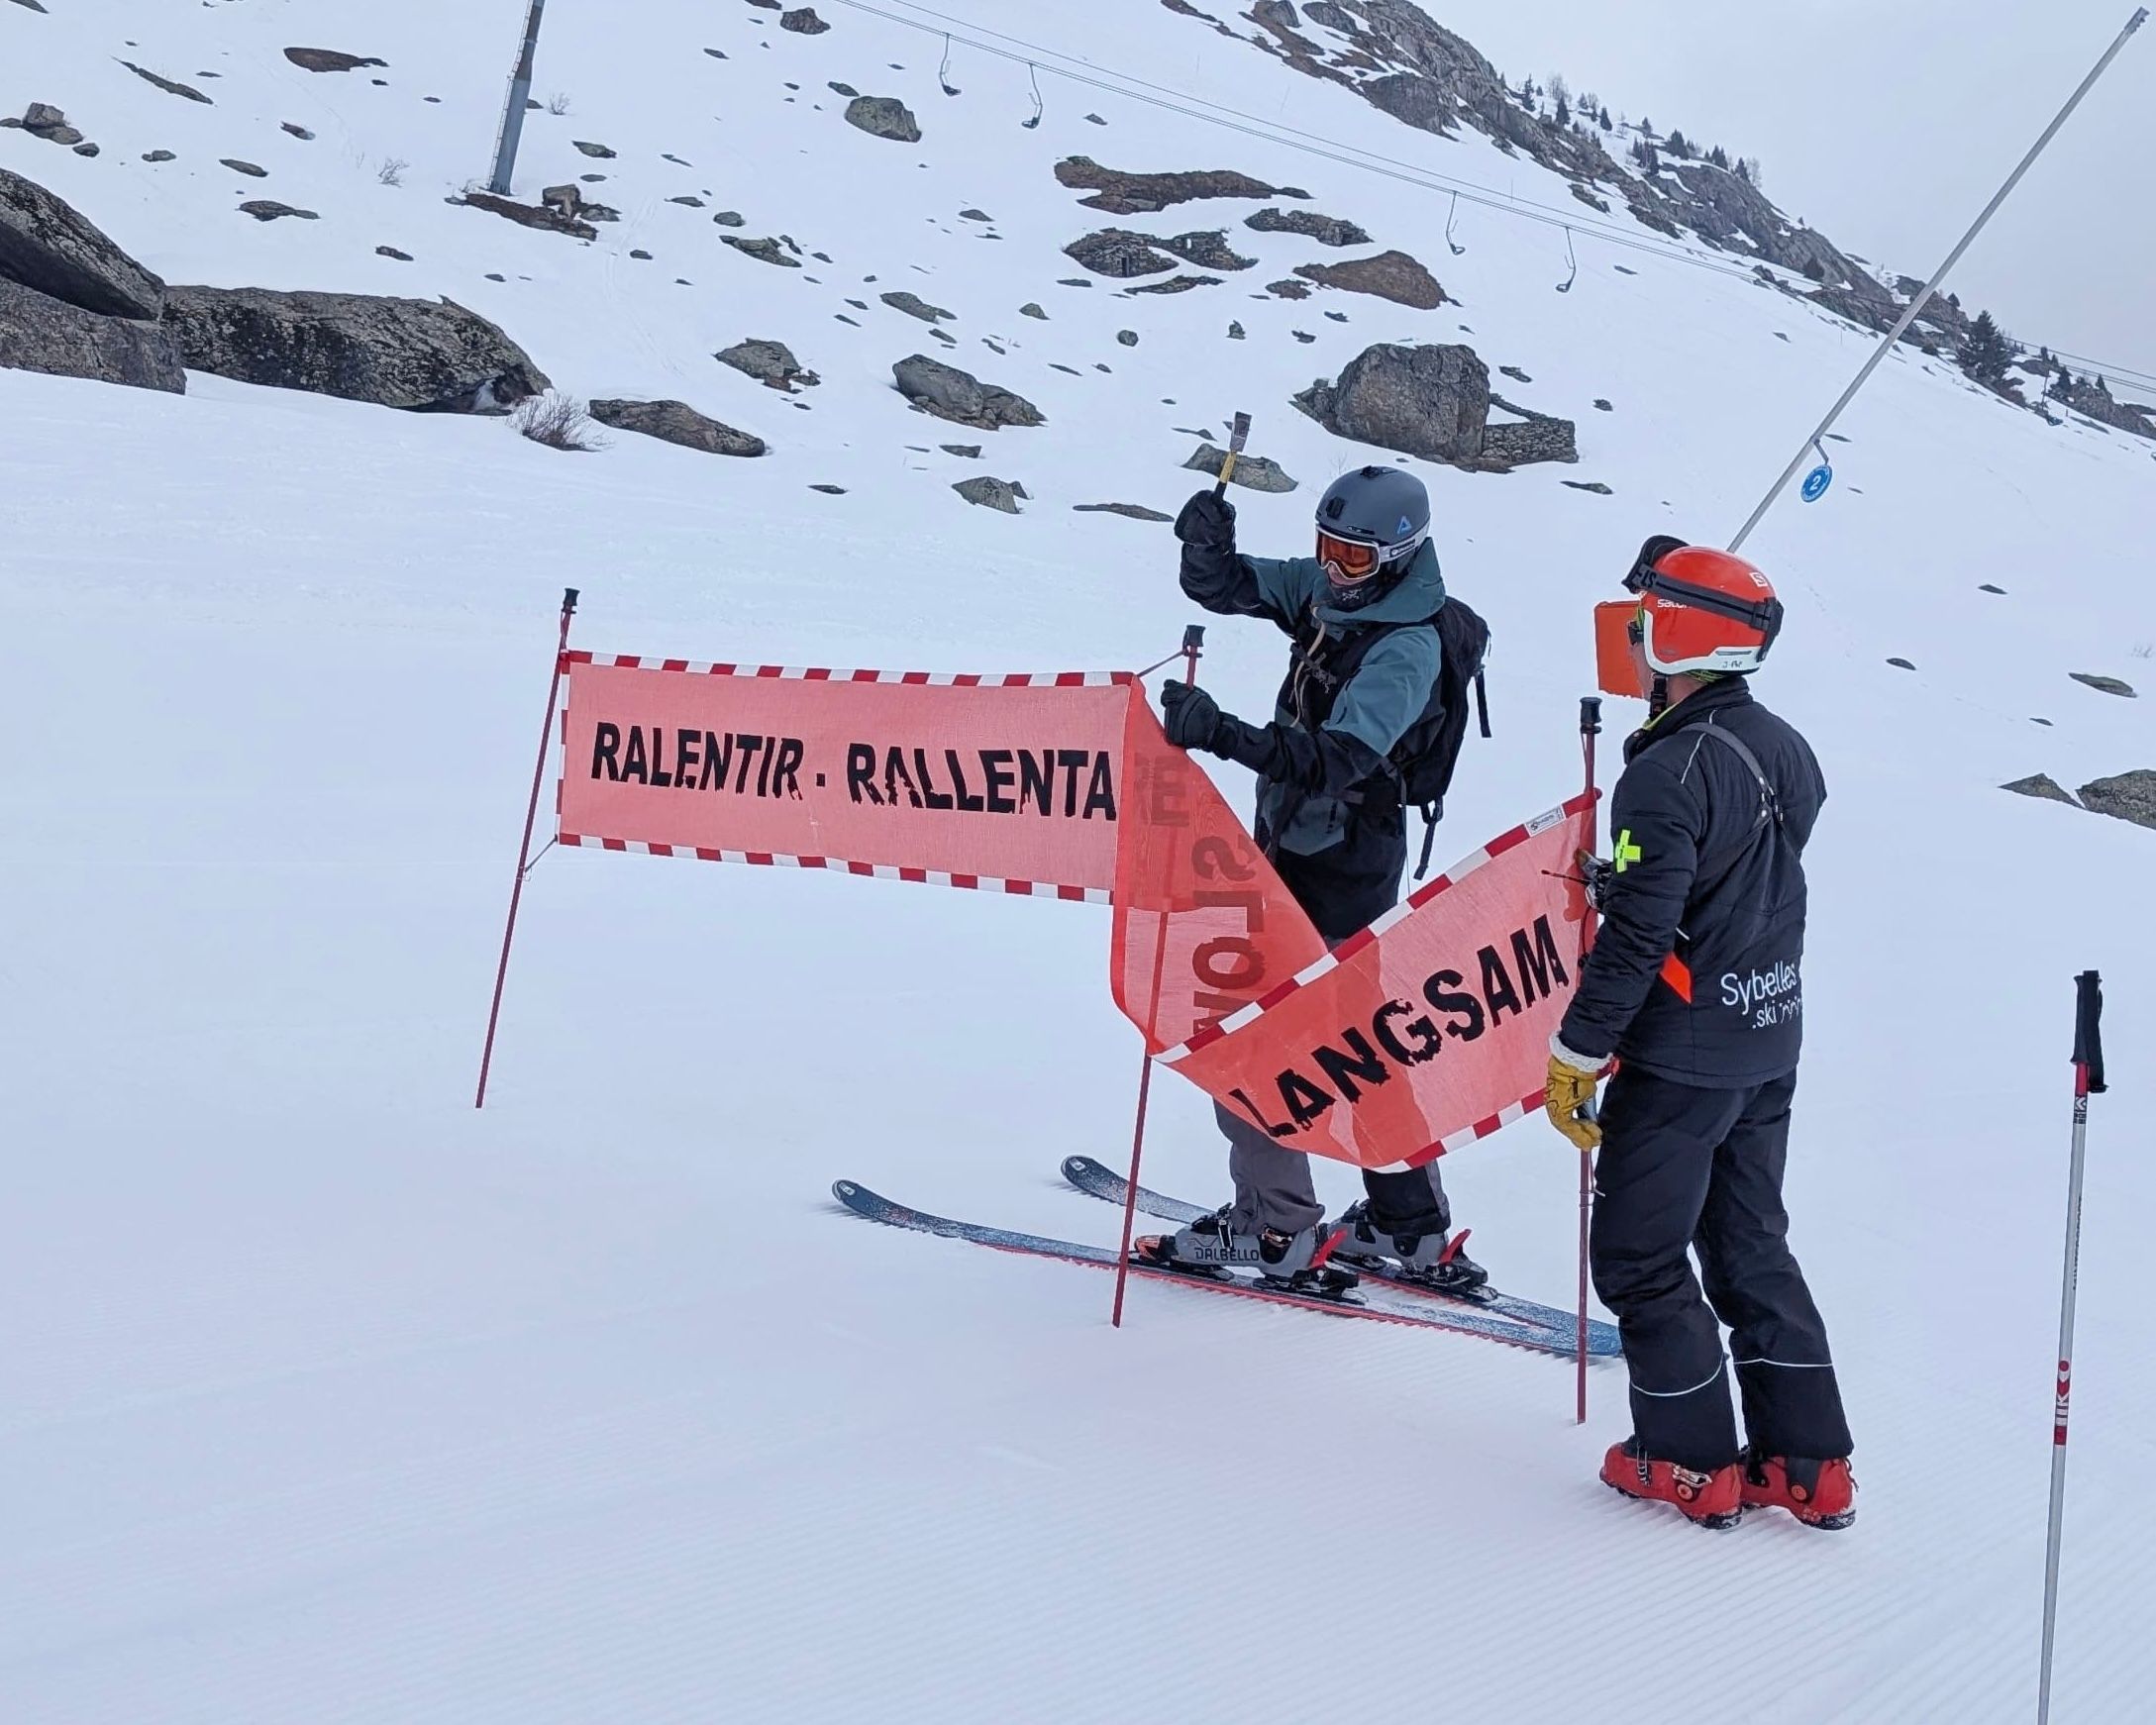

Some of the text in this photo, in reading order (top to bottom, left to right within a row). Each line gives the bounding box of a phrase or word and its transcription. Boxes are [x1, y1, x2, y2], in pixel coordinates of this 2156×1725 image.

[1809, 474, 1822, 491] 2
[591, 722, 804, 800] RALENTIR
[1720, 960, 1797, 1015] Sybelles
[1229, 913, 1570, 1139] LANGSAM
[1194, 1247, 1260, 1262] DALBELLO
